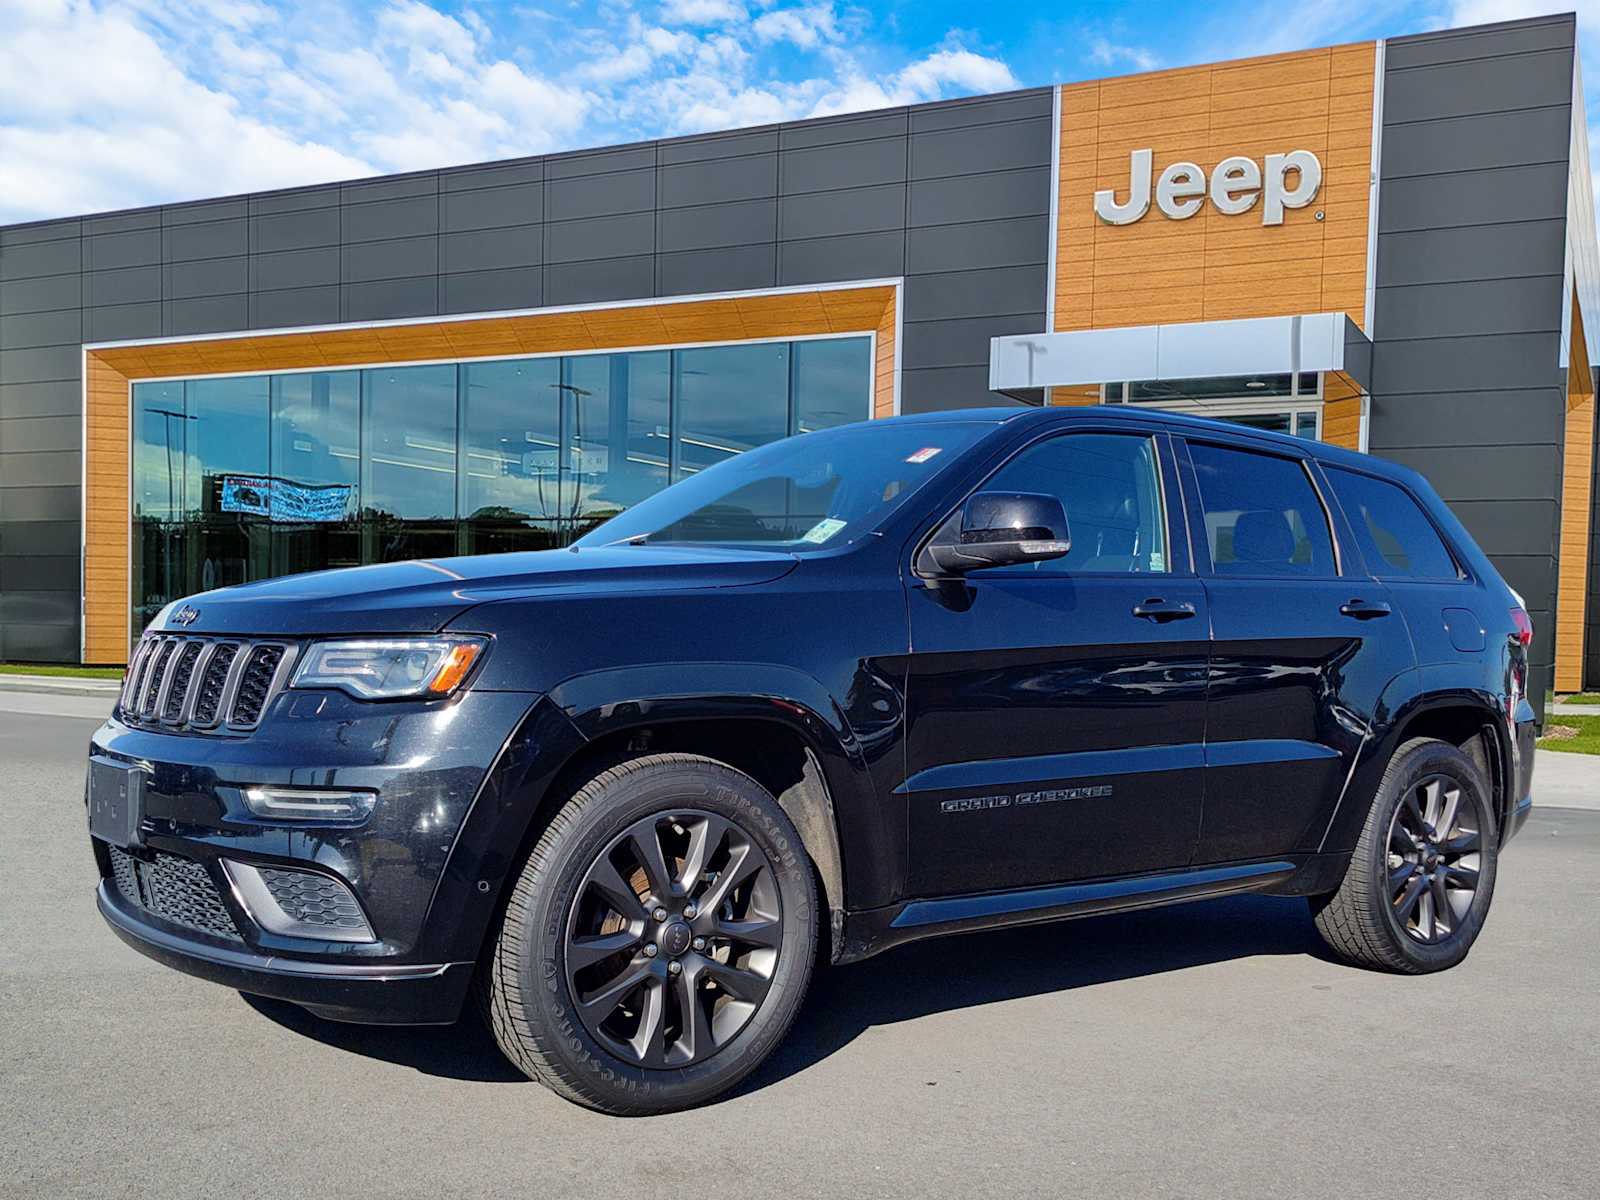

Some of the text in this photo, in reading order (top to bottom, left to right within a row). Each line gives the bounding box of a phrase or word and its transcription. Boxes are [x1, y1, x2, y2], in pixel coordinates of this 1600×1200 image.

[1094, 148, 1322, 226] Jeep
[941, 785, 1113, 812] GRAND CHEROKEE
